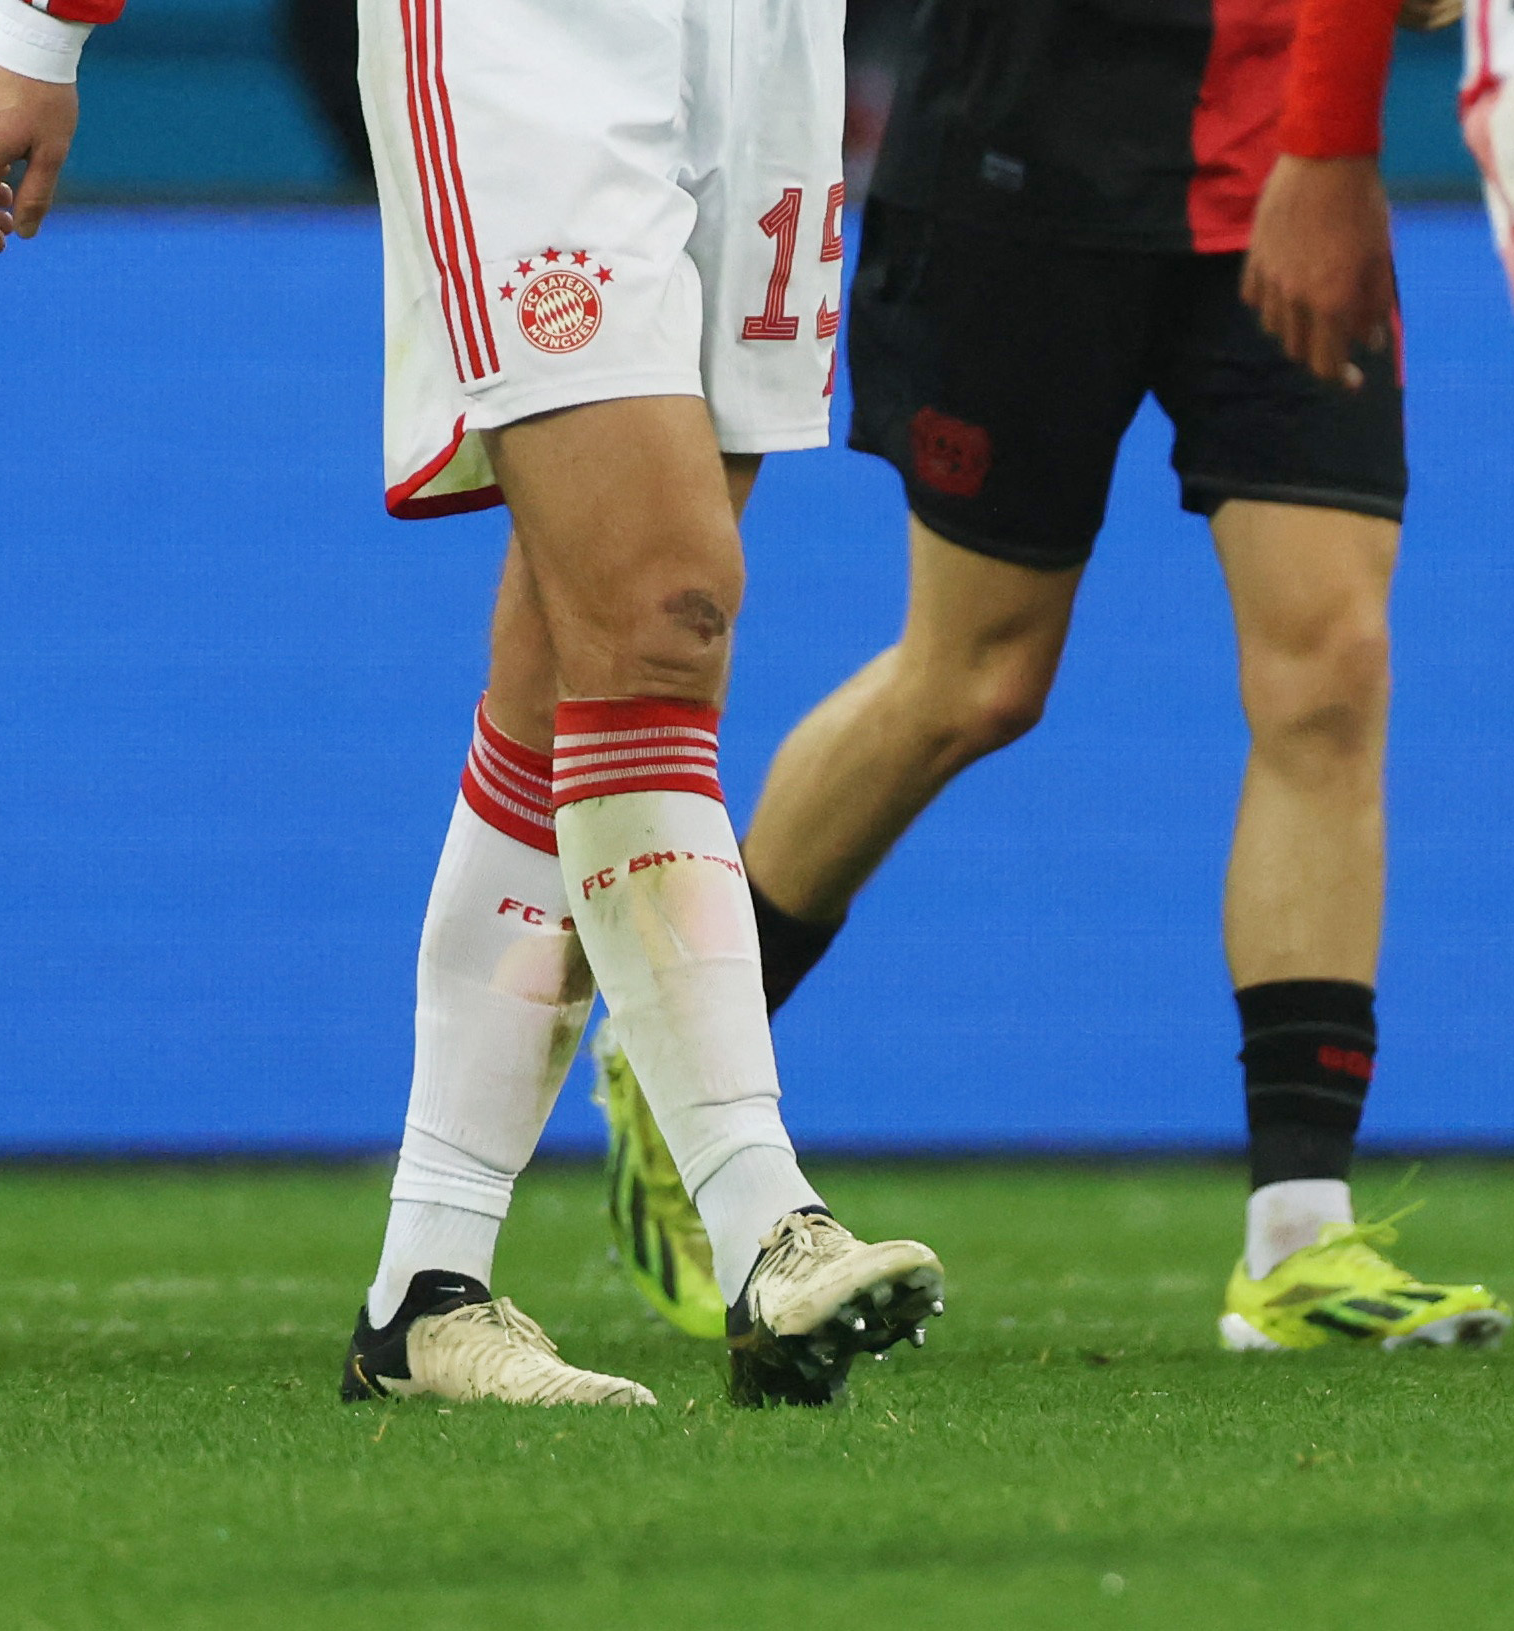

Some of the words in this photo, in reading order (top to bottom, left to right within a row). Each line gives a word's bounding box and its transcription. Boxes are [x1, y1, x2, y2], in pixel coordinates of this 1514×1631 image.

[524, 291, 539, 311] FC
[536, 275, 593, 303] BAYERN
[582, 867, 616, 901] FC
[497, 897, 546, 926] FC
